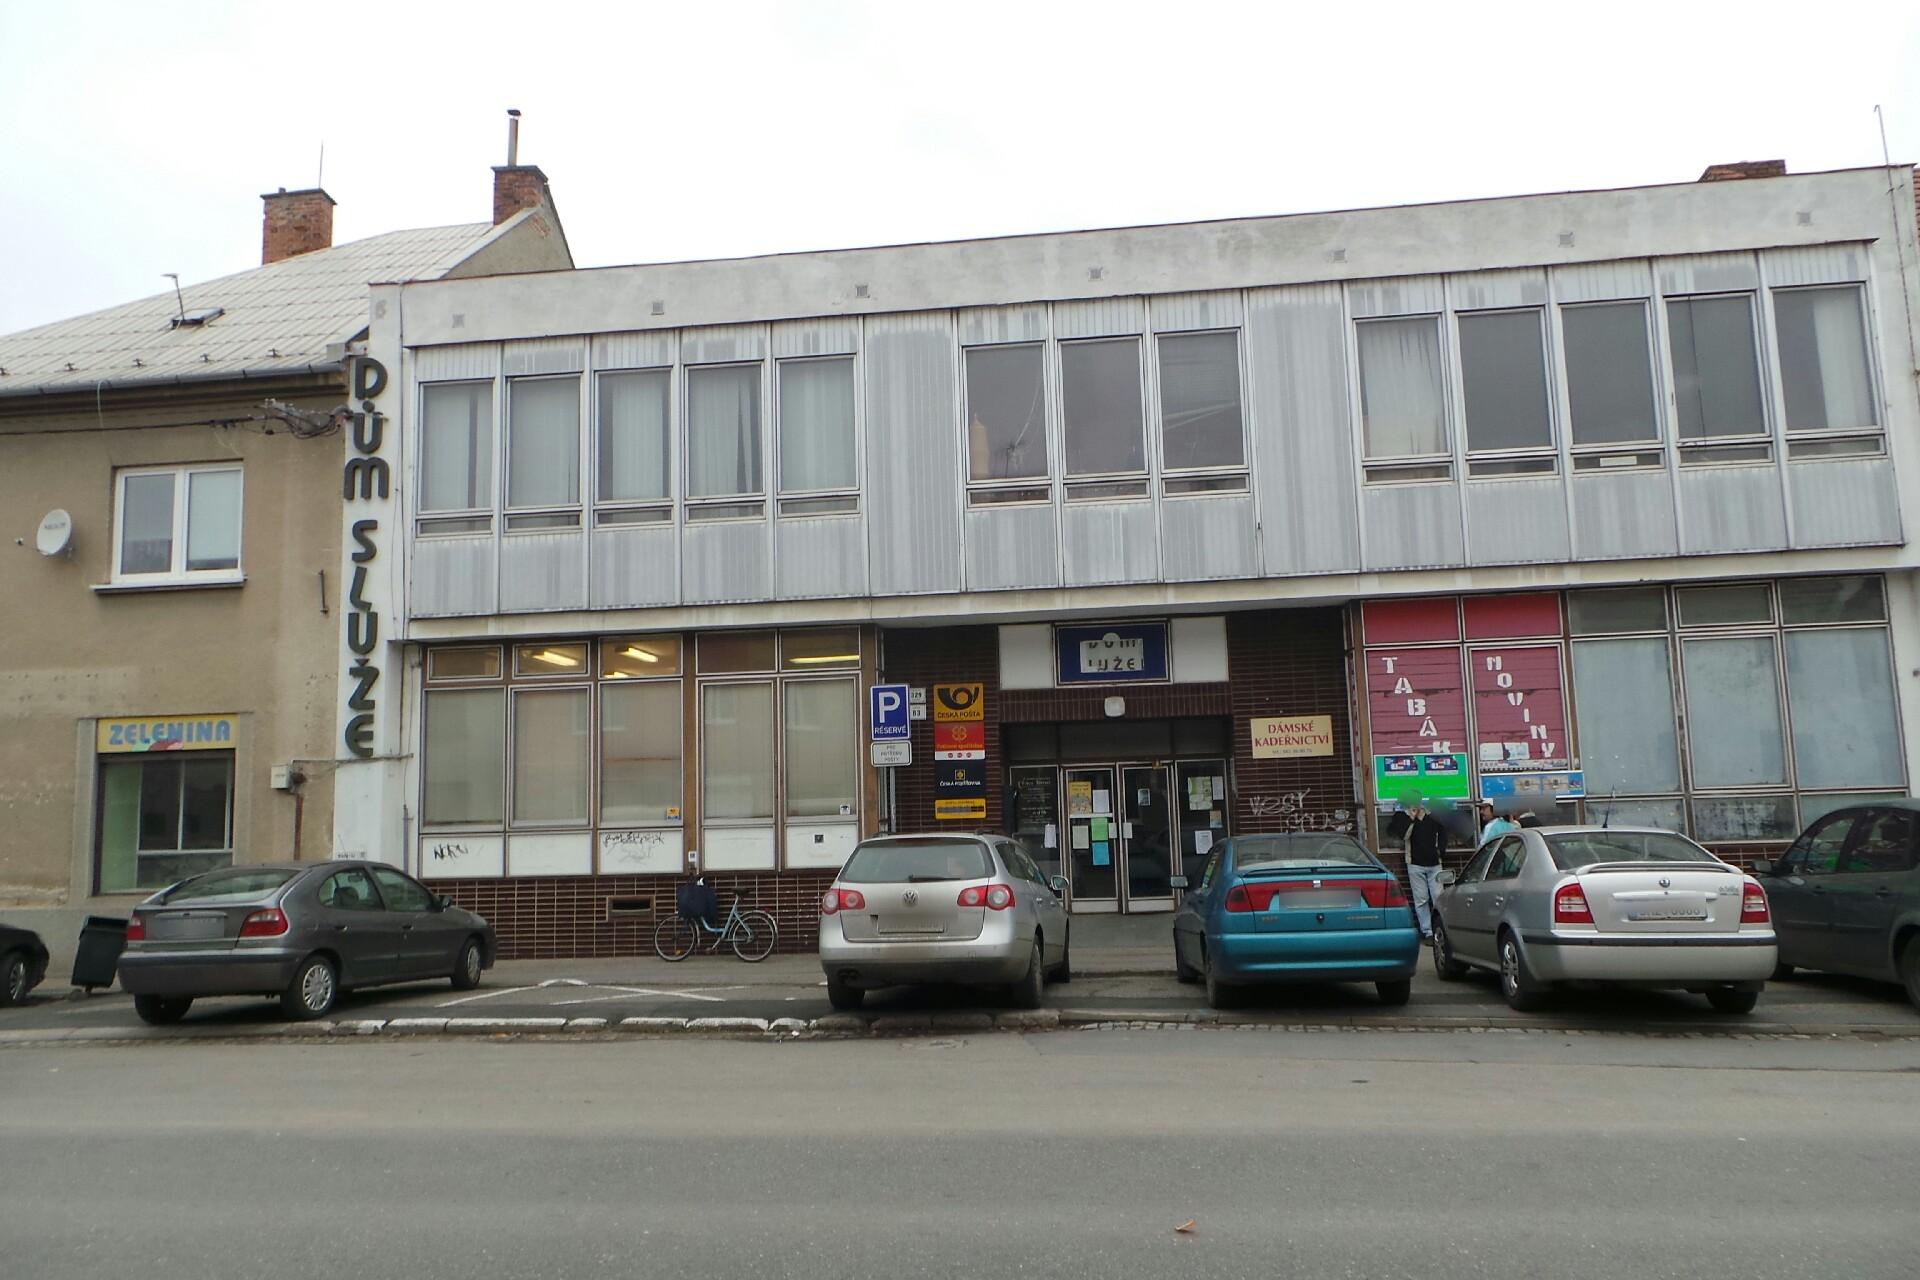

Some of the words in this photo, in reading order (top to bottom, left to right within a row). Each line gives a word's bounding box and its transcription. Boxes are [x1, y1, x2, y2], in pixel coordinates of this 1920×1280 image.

[344, 357, 389, 501] DŮM
[345, 519, 380, 758] SLUŽE
[879, 691, 901, 723] P
[960, 710, 981, 718] POŠTA
[1382, 657, 1451, 754] TABÁK
[1486, 656, 1556, 758] NOVINY
[109, 720, 231, 745] ZELENINA
[874, 725, 907, 735] RÉSERVÉ
[1254, 732, 1329, 747] KADEŘNICTVÍ
[1268, 720, 1314, 734] DÁMSKÉ
